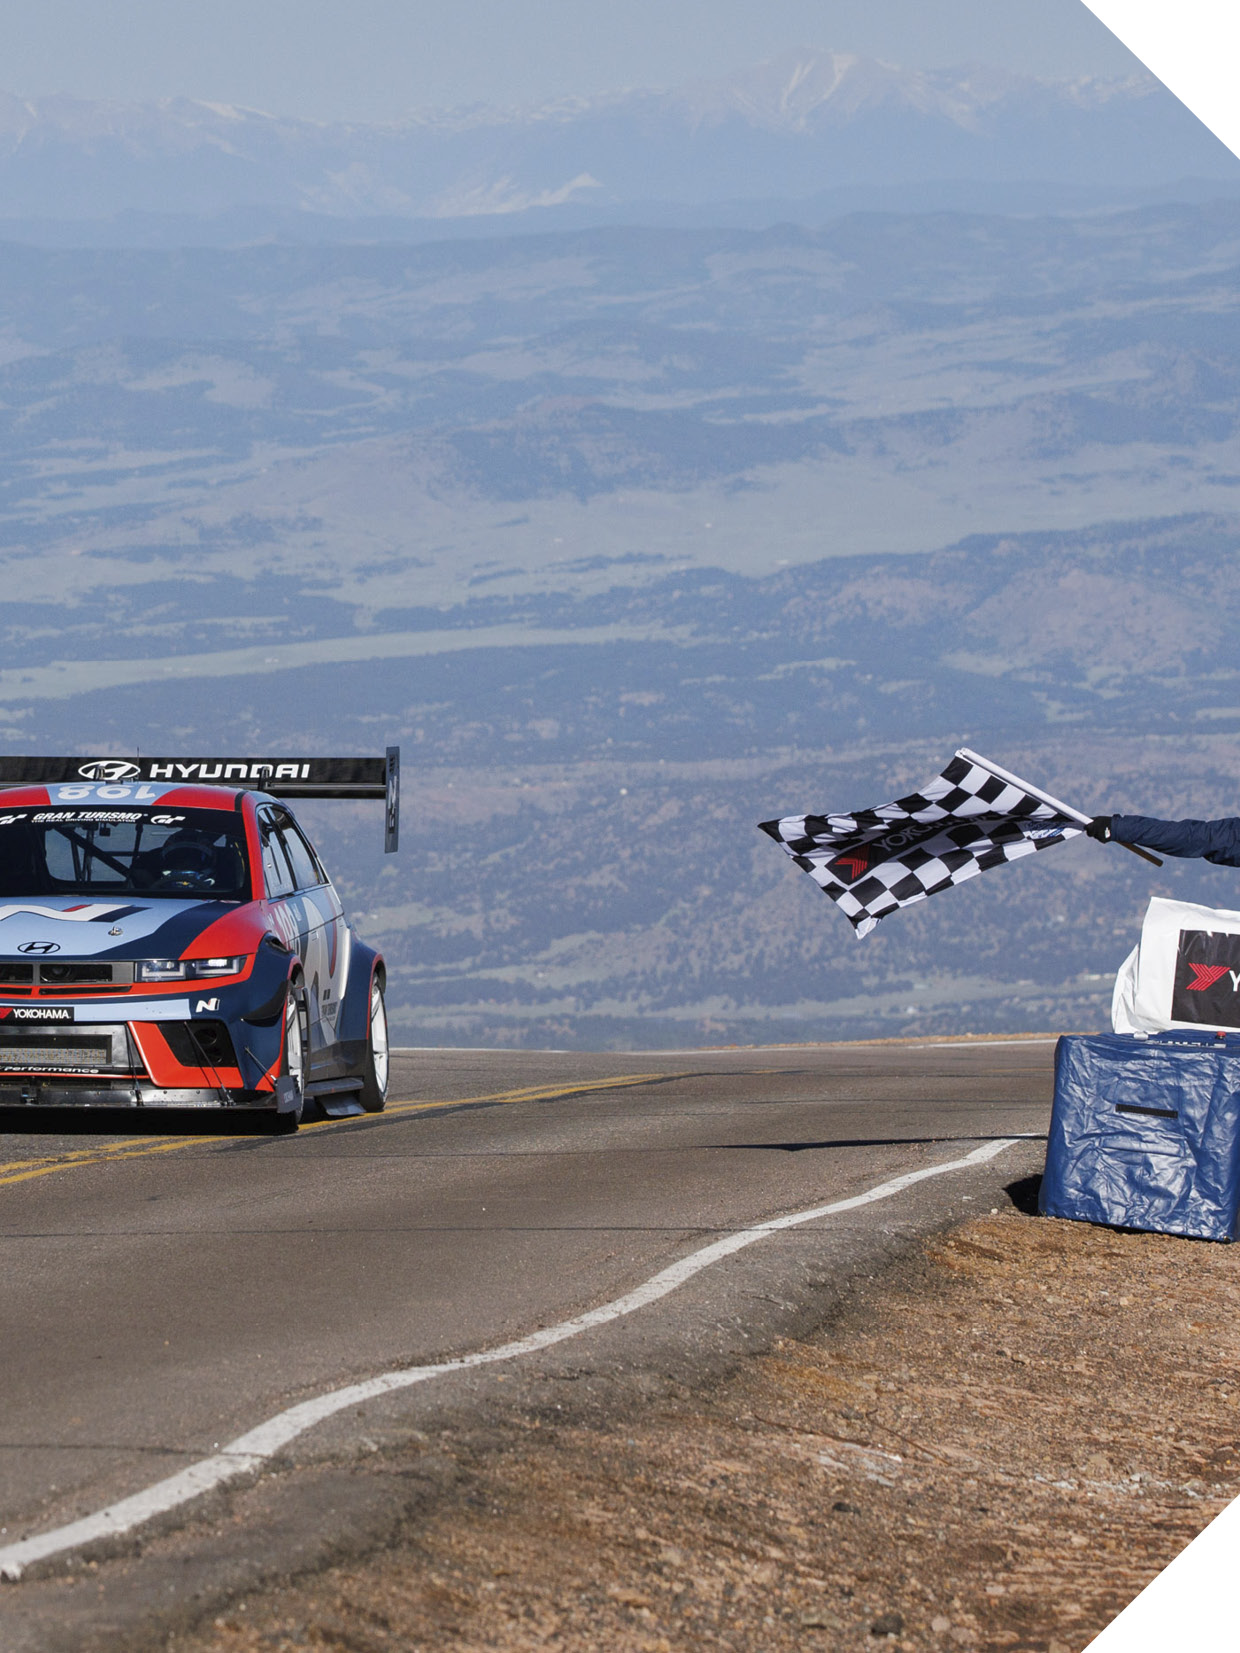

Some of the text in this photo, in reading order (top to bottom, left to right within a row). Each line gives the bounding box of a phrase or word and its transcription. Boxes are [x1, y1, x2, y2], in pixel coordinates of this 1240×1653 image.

[149, 763, 310, 779] HYUNDAI
[58, 785, 156, 800] 198
[33, 811, 144, 821] GRAN TURISMO
[13, 1008, 70, 1019] YOKOHAMA
